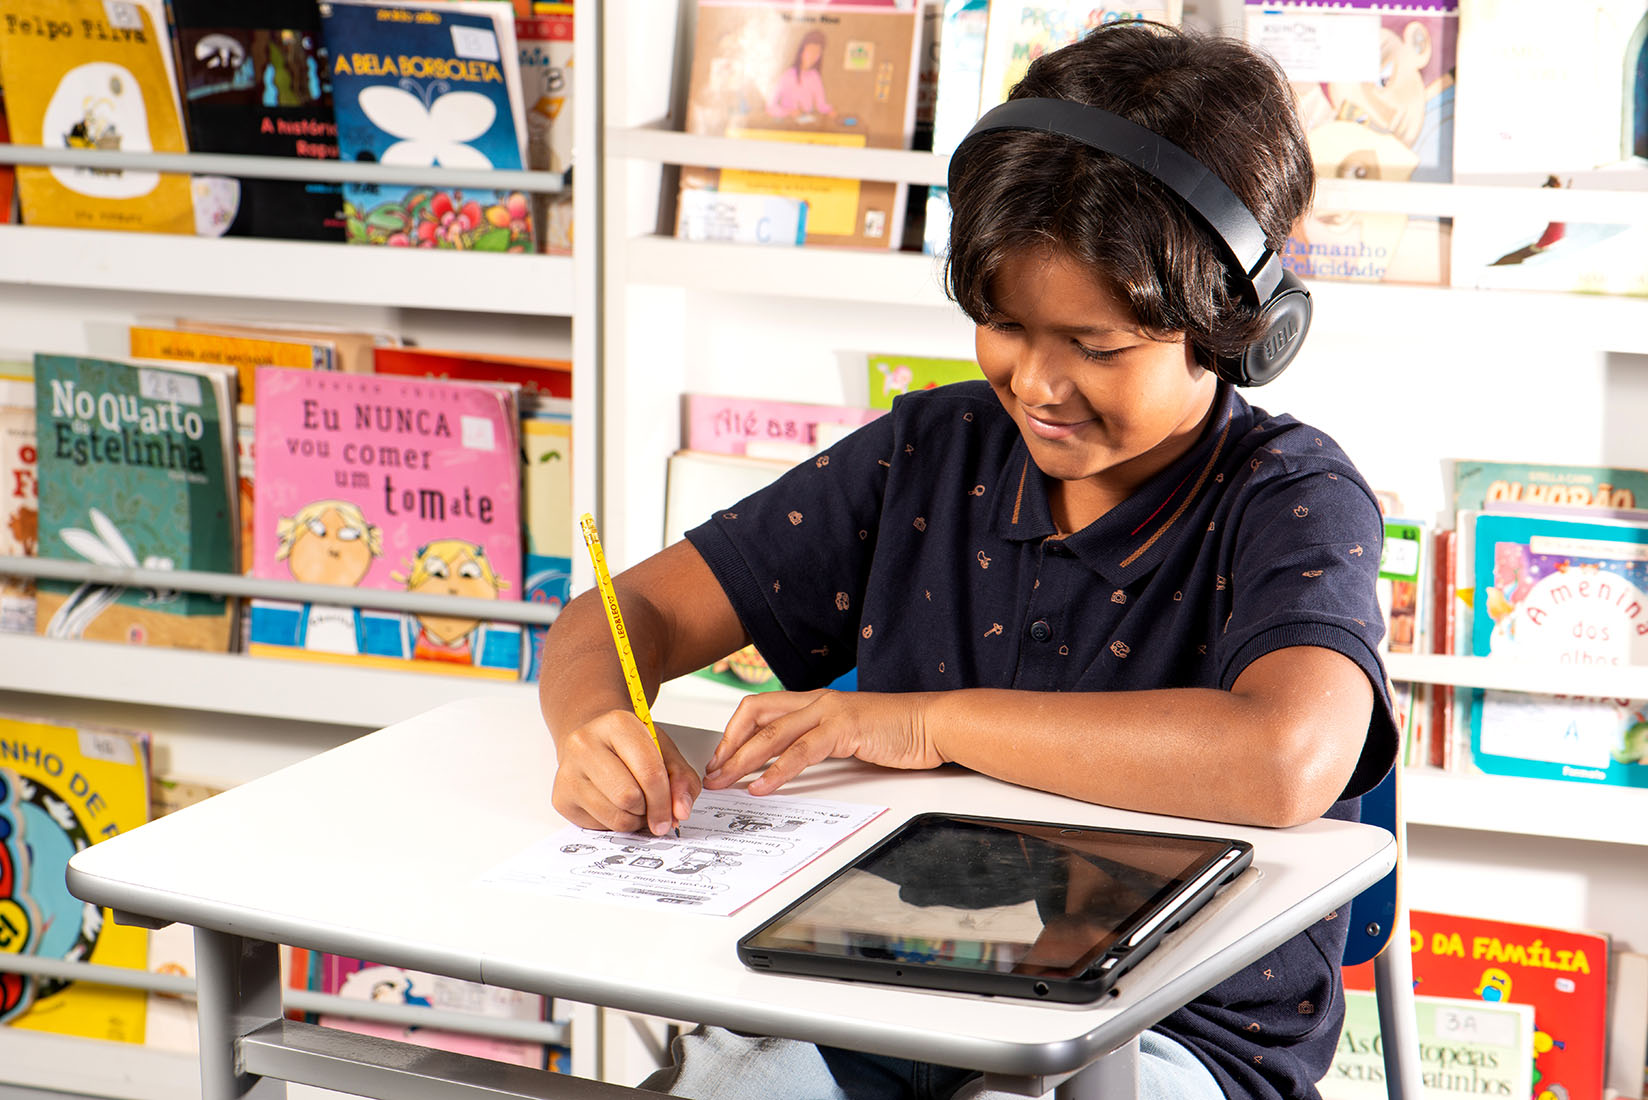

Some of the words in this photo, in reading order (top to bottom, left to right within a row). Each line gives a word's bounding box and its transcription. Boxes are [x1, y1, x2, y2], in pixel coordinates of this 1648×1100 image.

[333, 54, 352, 75] A
[352, 53, 398, 76] BELA
[398, 55, 503, 83] BORBOLETA
[261, 116, 275, 134] A
[1285, 237, 1387, 256] Tamanho
[1281, 257, 1386, 278] Felicidade
[50, 379, 95, 420] No
[98, 392, 204, 440] Quarto
[302, 399, 341, 431] Eu
[354, 404, 452, 438] NUNCA
[55, 421, 206, 474] Estelinha
[286, 437, 331, 458] vou
[343, 441, 432, 470] comer
[334, 470, 371, 489] um
[383, 474, 495, 525] tomate
[1526, 606, 1548, 626] A
[1571, 621, 1611, 641] dos
[69, 772, 108, 819] DE
[1432, 932, 1465, 958] DA
[1472, 936, 1591, 975] FAMÍLIA
[1445, 1012, 1478, 1033] 3A
